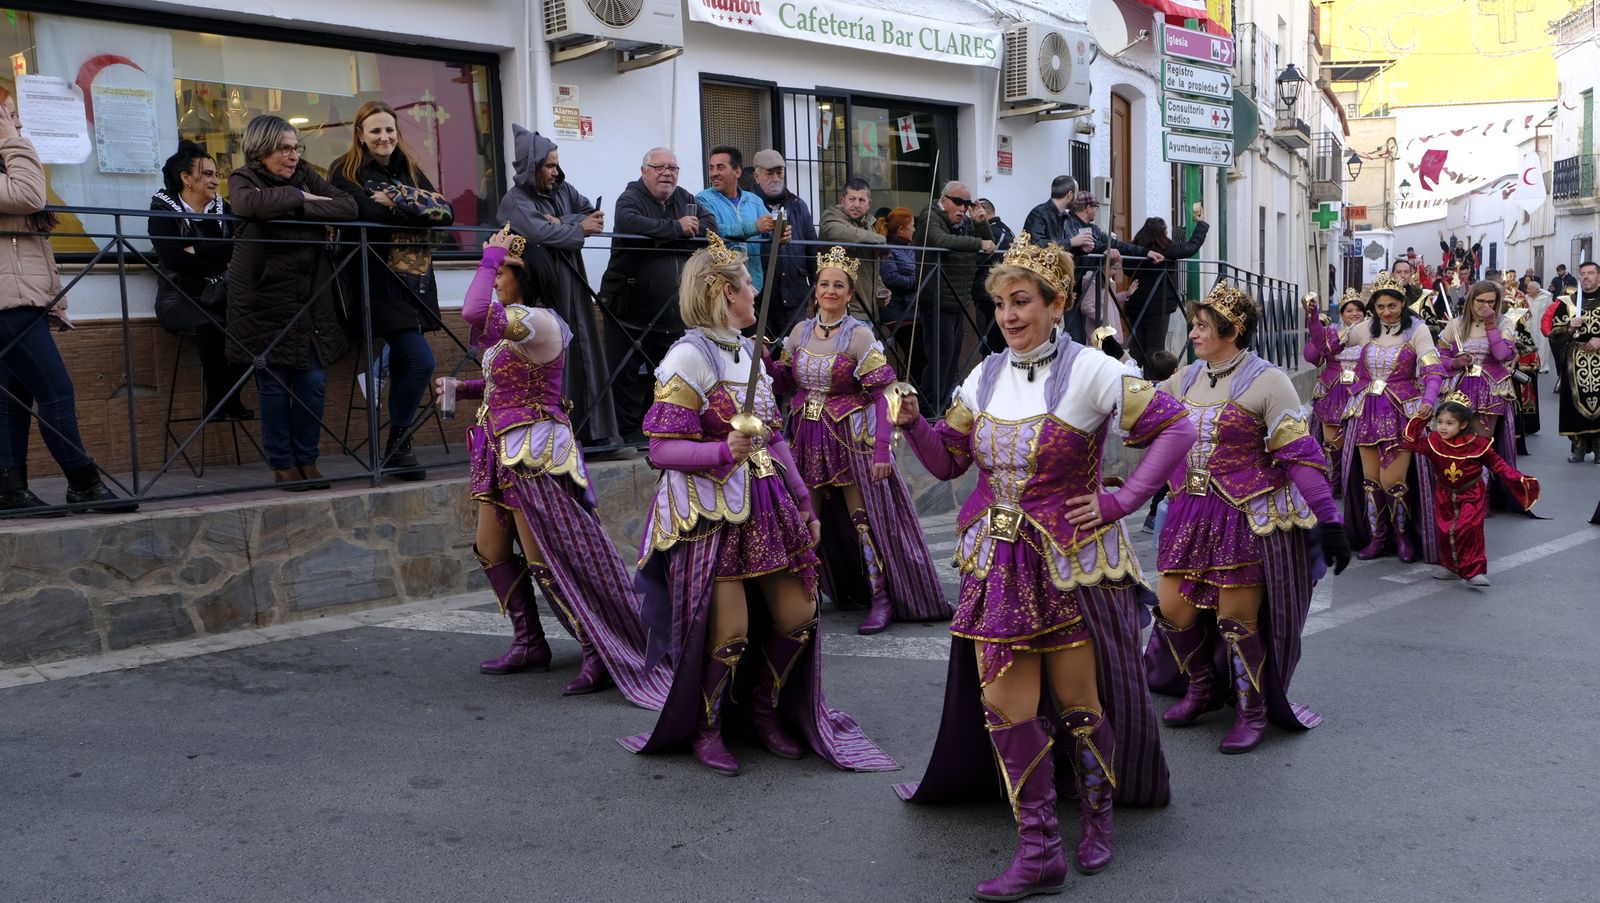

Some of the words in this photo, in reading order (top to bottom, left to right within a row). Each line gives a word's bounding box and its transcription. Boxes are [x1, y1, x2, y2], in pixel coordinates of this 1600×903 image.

[778, 3, 876, 42] Cafetería
[881, 20, 914, 49] Bar
[919, 27, 997, 60] CLARES
[1167, 33, 1188, 48] Iglesia
[1077, 56, 1085, 65] LG
[1167, 64, 1194, 78] Registro
[1167, 76, 1175, 86] de
[1178, 77, 1185, 88] la
[1188, 80, 1218, 94] propiedad
[554, 107, 578, 116] Alarma
[1167, 101, 1204, 115] Consultorio
[1167, 114, 1191, 125] médico
[1168, 141, 1212, 155] Ayuntamiento
